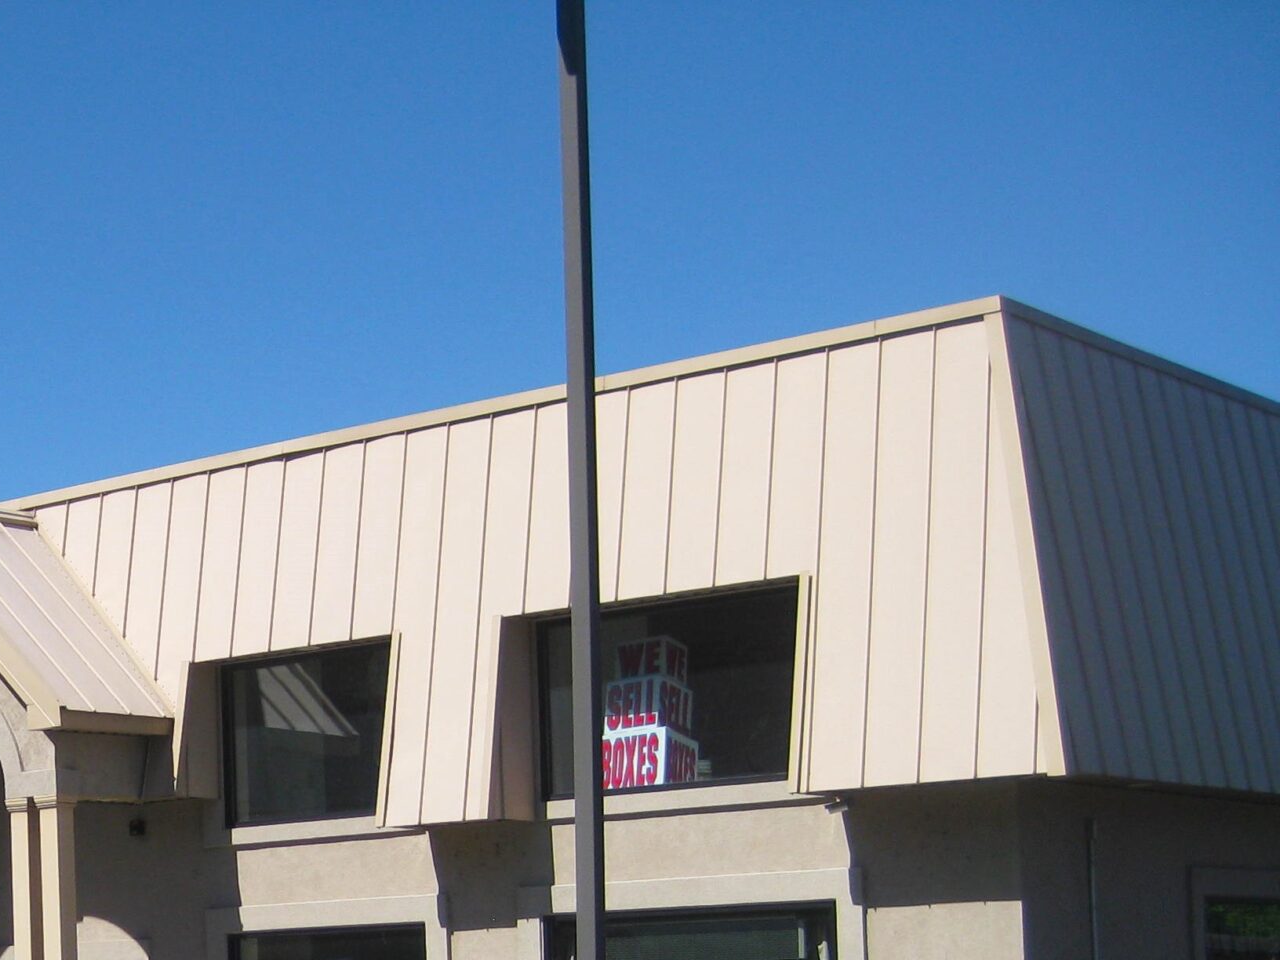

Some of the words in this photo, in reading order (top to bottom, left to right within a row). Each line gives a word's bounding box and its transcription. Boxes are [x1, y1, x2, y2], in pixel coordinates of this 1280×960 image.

[617, 641, 660, 677] WE
[606, 679, 656, 730] SELL
[601, 733, 658, 789] BOXES
